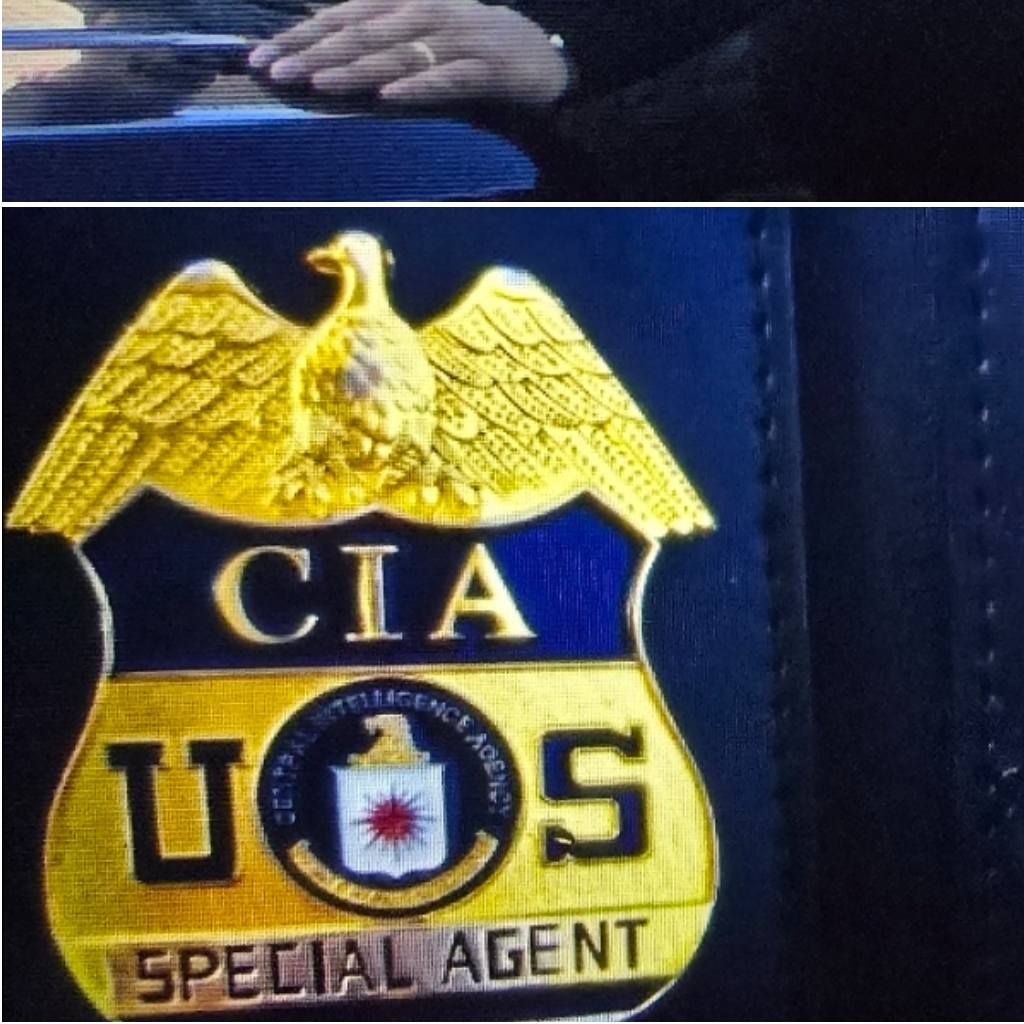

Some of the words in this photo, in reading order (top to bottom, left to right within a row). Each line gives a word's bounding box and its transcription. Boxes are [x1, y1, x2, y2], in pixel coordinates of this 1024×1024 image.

[212, 542, 536, 645] CIA
[134, 933, 418, 1004] SPECIAL
[440, 917, 649, 986] AGENT
